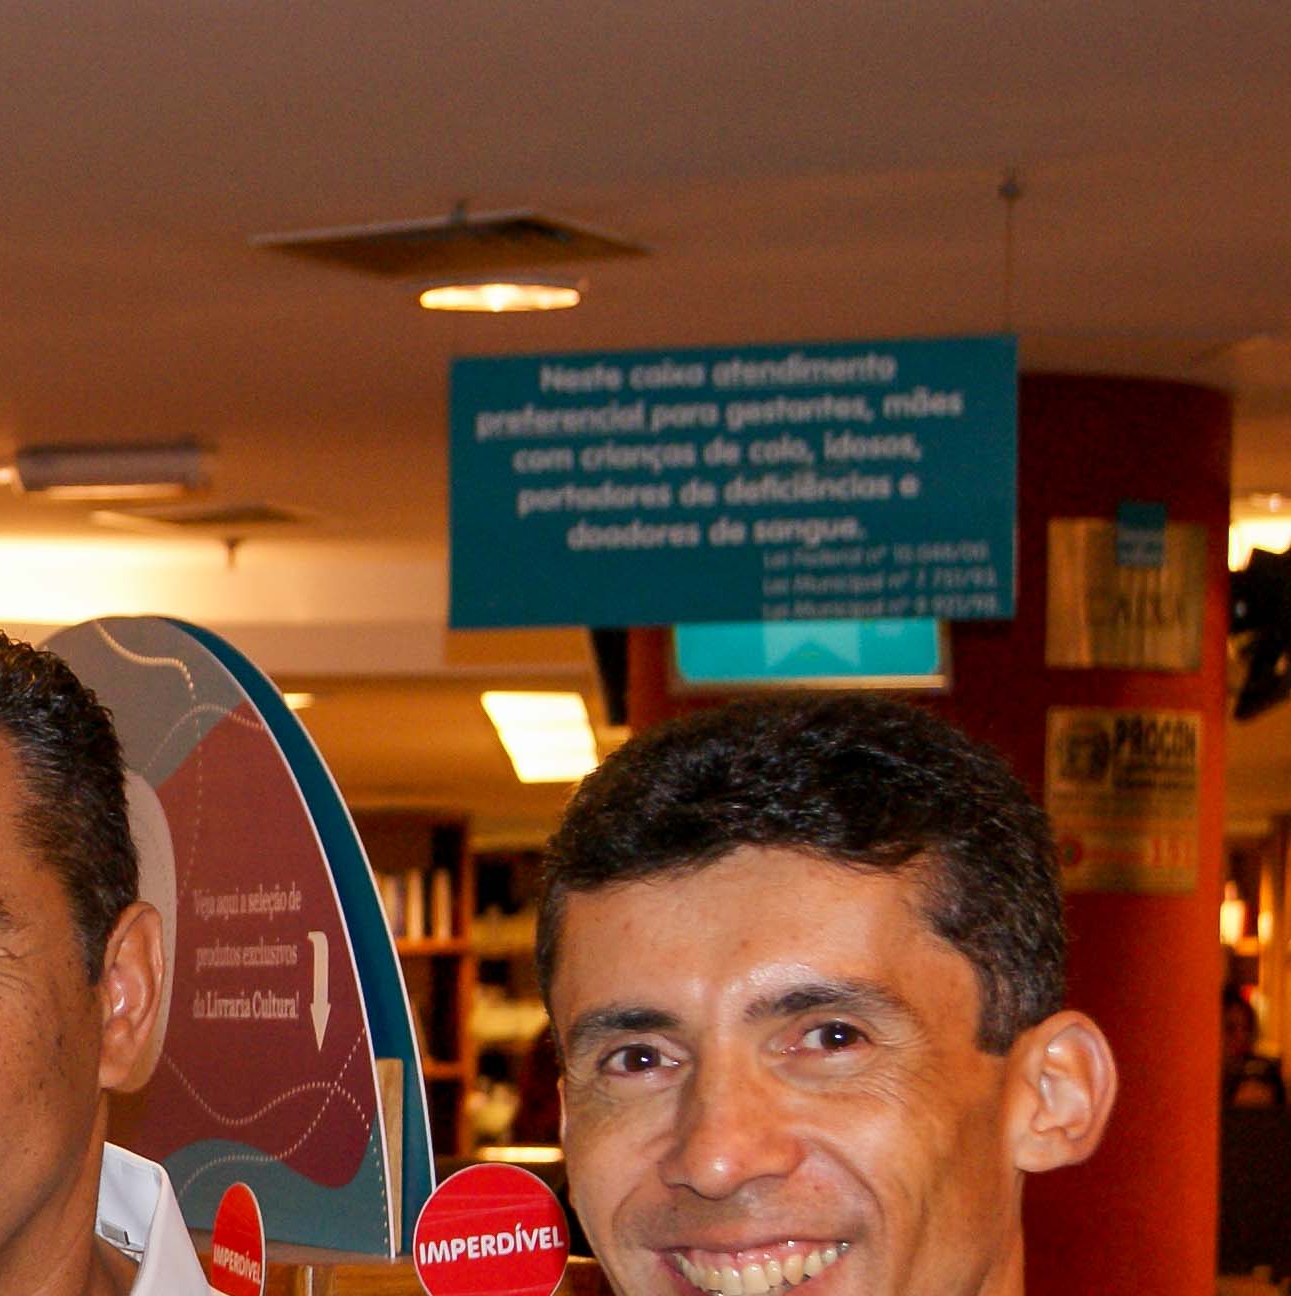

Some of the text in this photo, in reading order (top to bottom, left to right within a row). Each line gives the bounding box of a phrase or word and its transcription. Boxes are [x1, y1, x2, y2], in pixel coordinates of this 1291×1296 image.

[540, 353, 897, 392] Neste caixa atendimento
[476, 386, 963, 441] preferencial para gestantes, mães
[513, 448, 574, 474] com
[581, 440, 696, 475] crianças
[704, 434, 741, 466] de
[749, 432, 815, 465] colo,
[516, 471, 918, 518] portadores de deficiências e
[568, 517, 865, 550] doadores de sangue.
[194, 881, 301, 921] Veja aqui a seleção de
[196, 936, 298, 972] produtos exclusivos
[206, 990, 251, 1018] Livraria
[252, 989, 299, 1019] Cultura!
[213, 1243, 261, 1285] IMPERDÍVEL
[419, 1222, 564, 1265] IMPERDÍVEL
